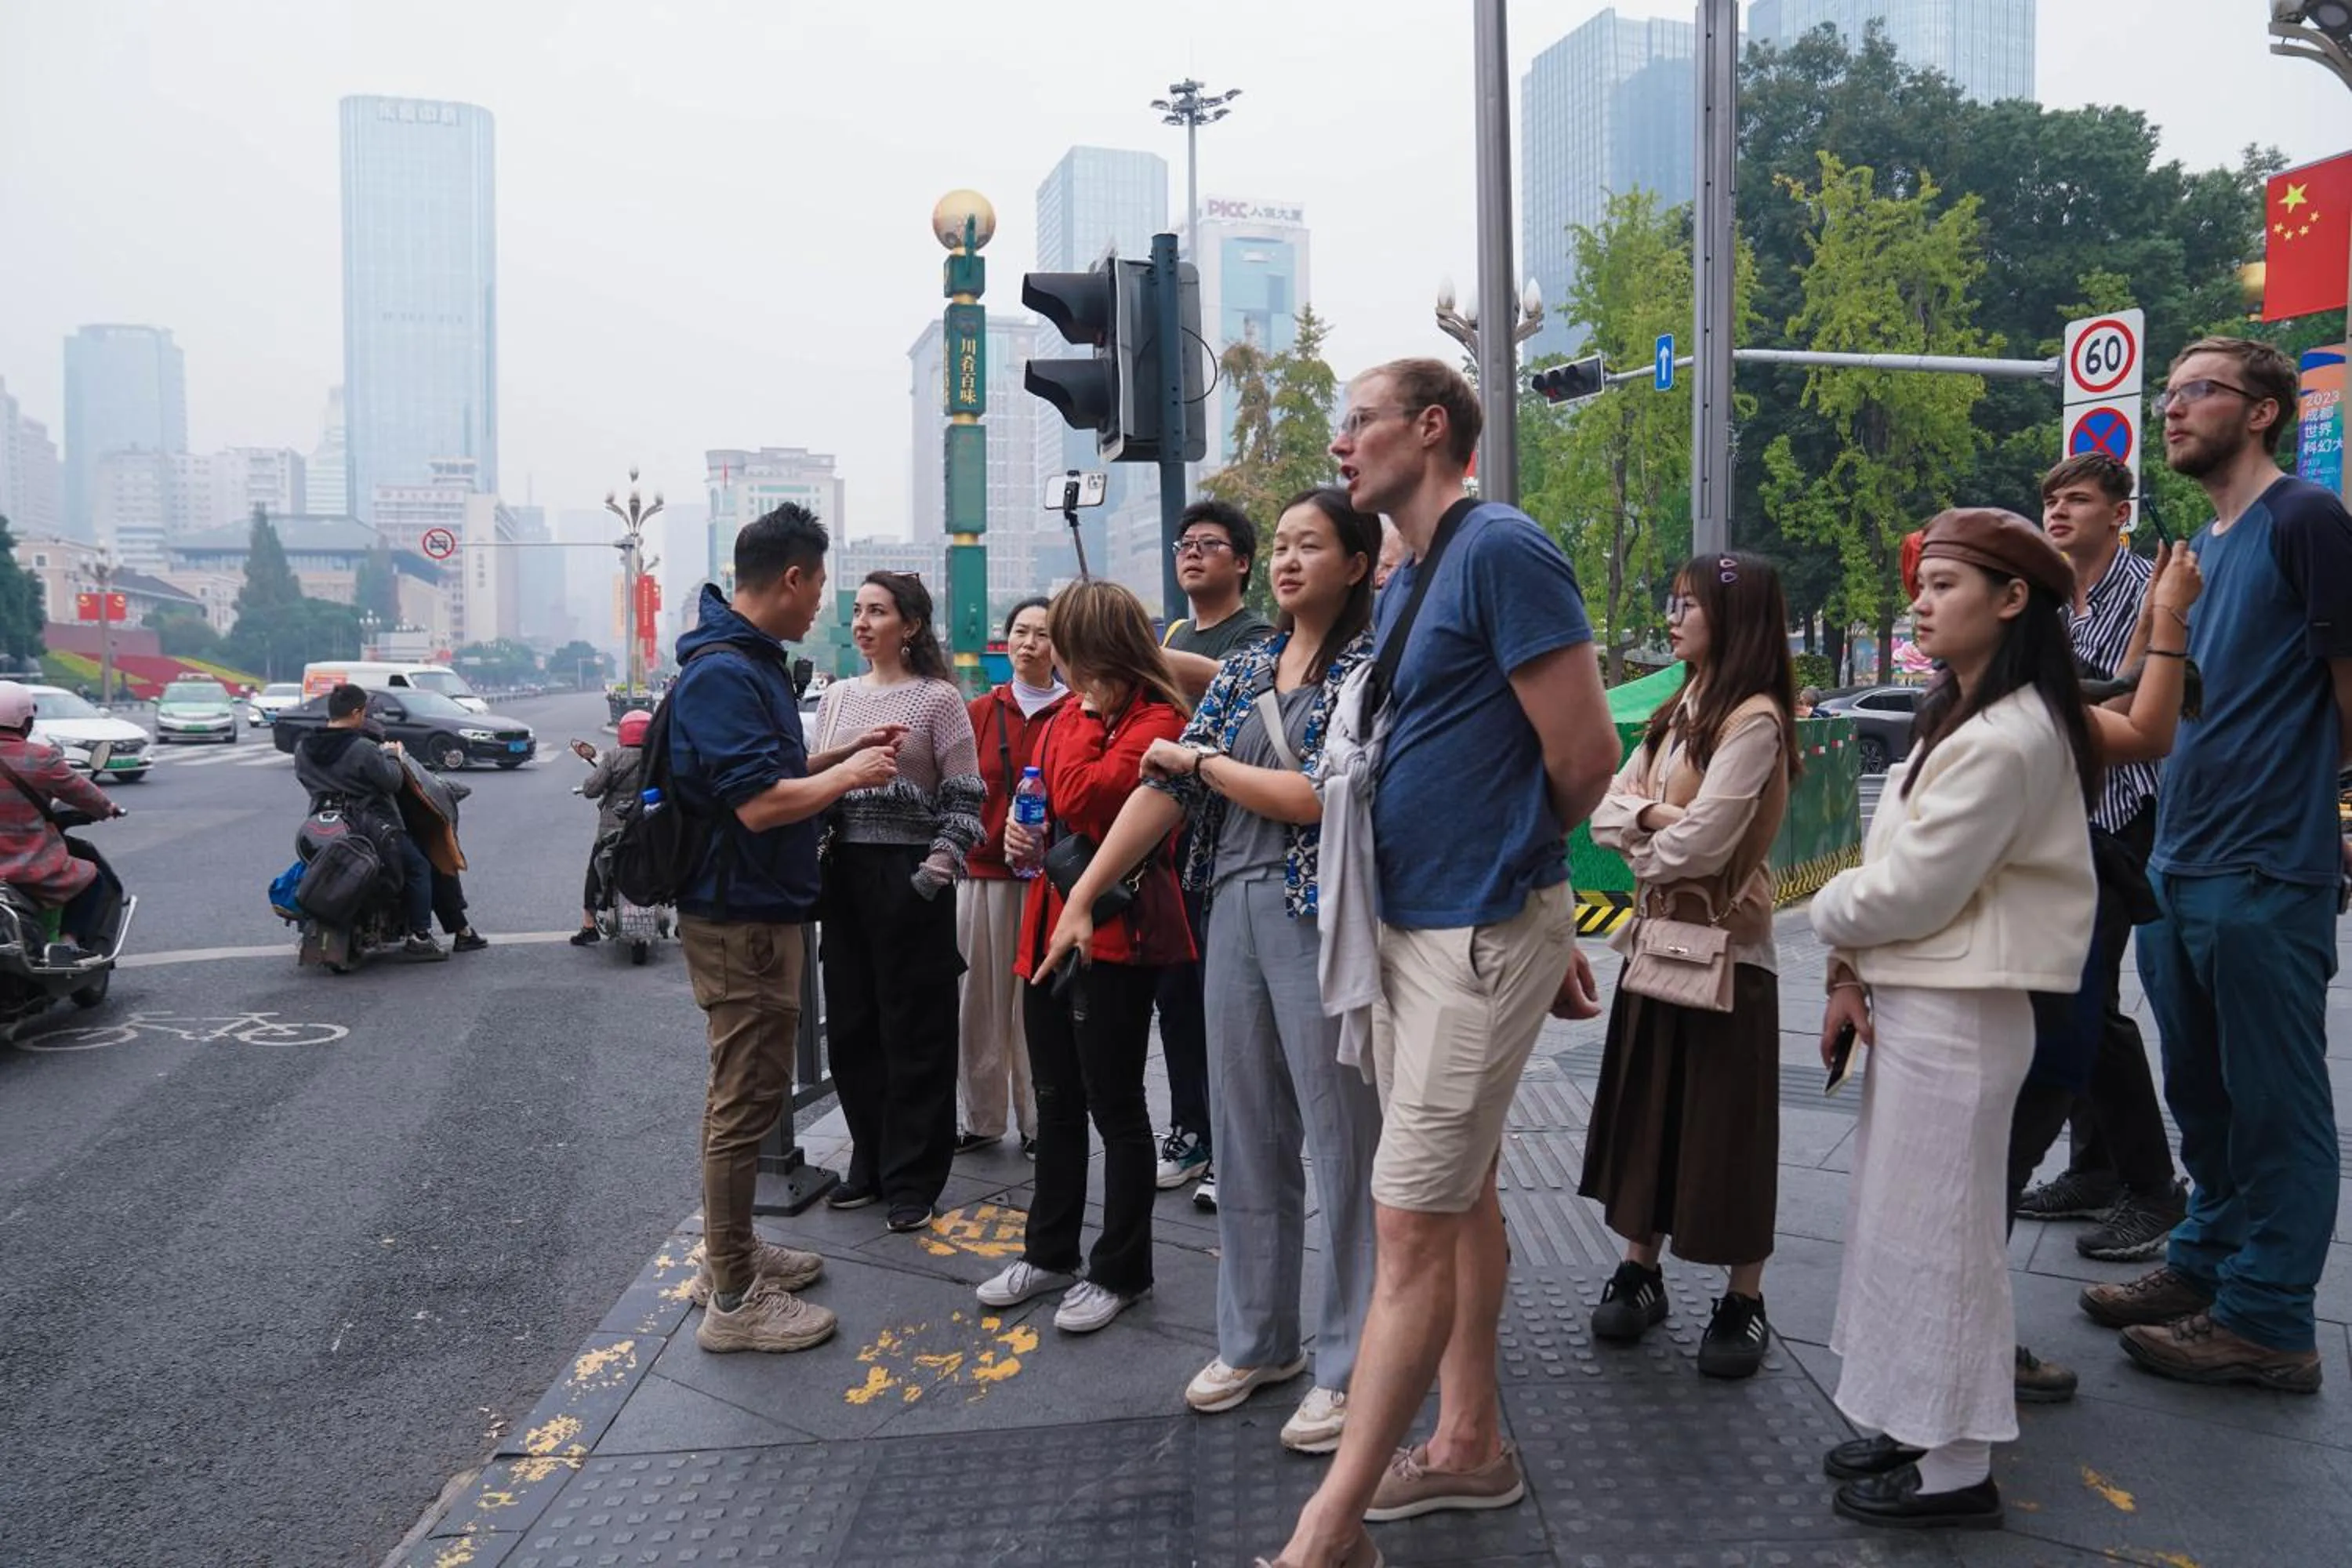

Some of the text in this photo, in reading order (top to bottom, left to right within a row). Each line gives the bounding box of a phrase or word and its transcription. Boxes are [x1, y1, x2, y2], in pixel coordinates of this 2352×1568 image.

[1207, 198, 1247, 219] PICC
[2085, 335, 2122, 375] 60
[2307, 390, 2340, 406] 2023
[2305, 406, 2334, 422] 成都
[2305, 422, 2332, 438] 世界
[2303, 436, 2343, 455] 科幻大
